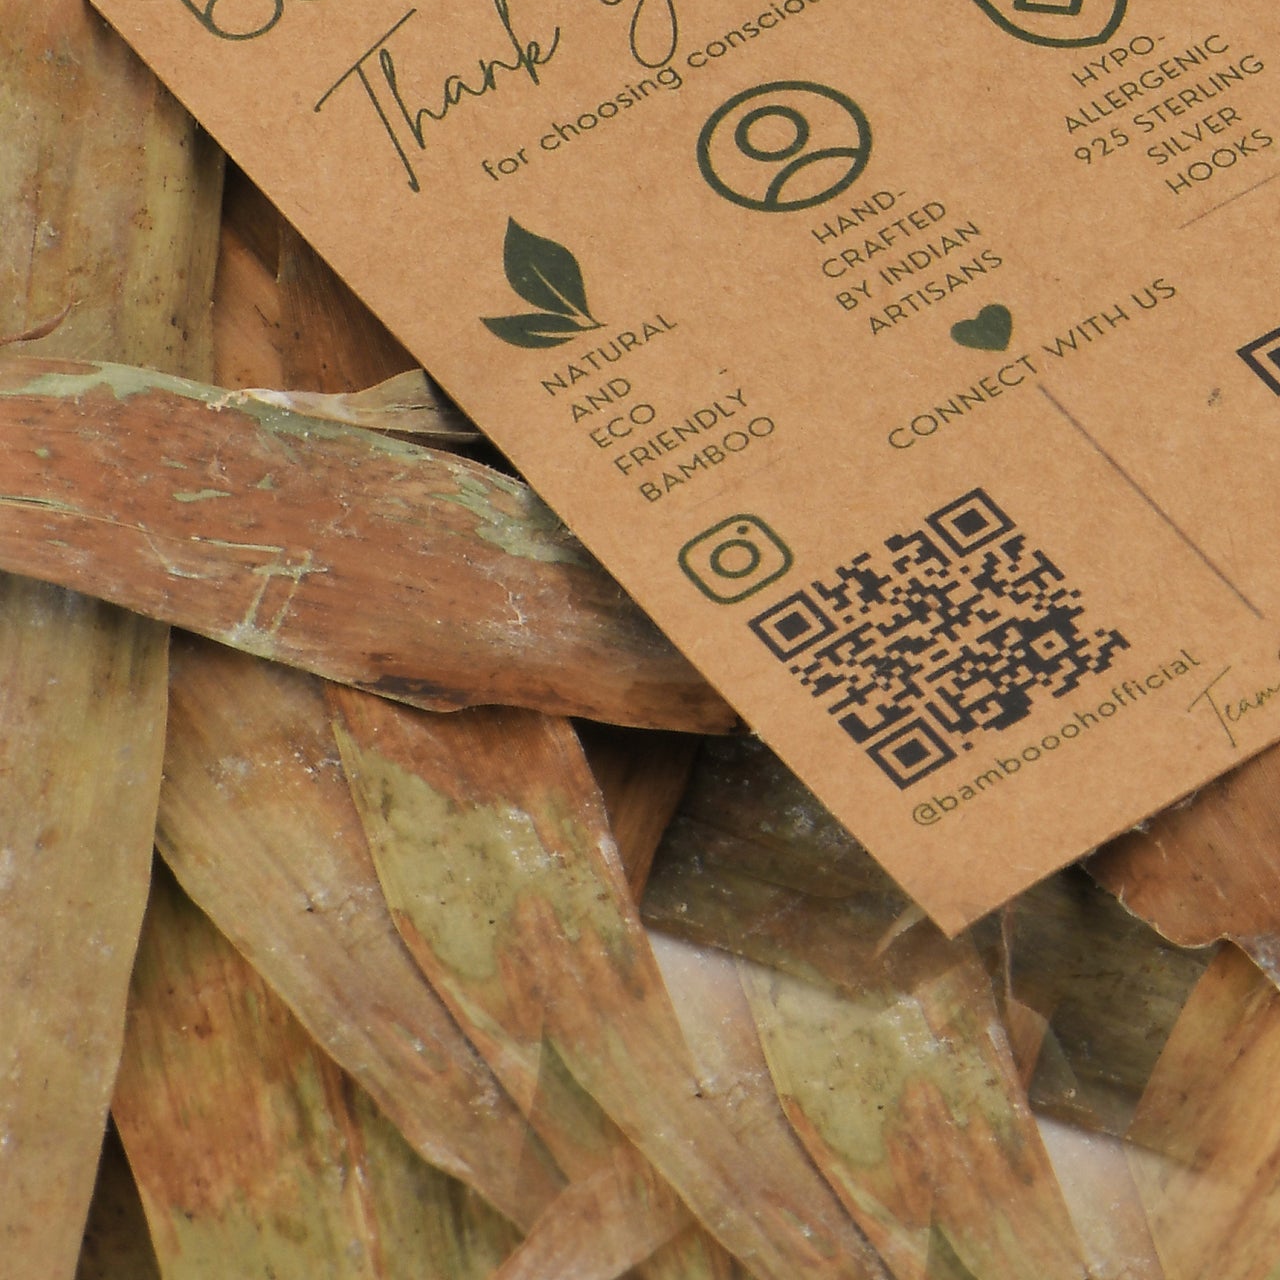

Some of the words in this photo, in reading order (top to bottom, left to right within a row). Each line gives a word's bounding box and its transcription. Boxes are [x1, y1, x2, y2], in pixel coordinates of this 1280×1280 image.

[1064, 34, 1230, 134] ALLERGENIC
[1071, 35, 1166, 88] HYPO-
[481, 147, 530, 181] for
[539, 65, 684, 152] choosing
[1074, 128, 1130, 165] 925
[1133, 54, 1265, 134] STERLING
[1146, 106, 1242, 166] SILVER
[1164, 128, 1274, 195] HOOKS
[811, 191, 906, 245] HAND-
[821, 201, 946, 278] CRAFTED
[835, 279, 873, 312] BY
[879, 221, 983, 286] INDIAN
[868, 249, 1003, 336] ARTISANS
[540, 314, 678, 397] NATURAL
[888, 354, 1038, 449] CONNECT
[1041, 304, 1130, 358] WITH
[1131, 277, 1177, 310] US
[570, 377, 631, 424] AND
[589, 404, 656, 448] ECO
[613, 387, 748, 476] FRIENDLY
[638, 416, 775, 503] BAMBOO
[912, 648, 1202, 826] @bambooohofficial
[1187, 665, 1280, 748] Team
